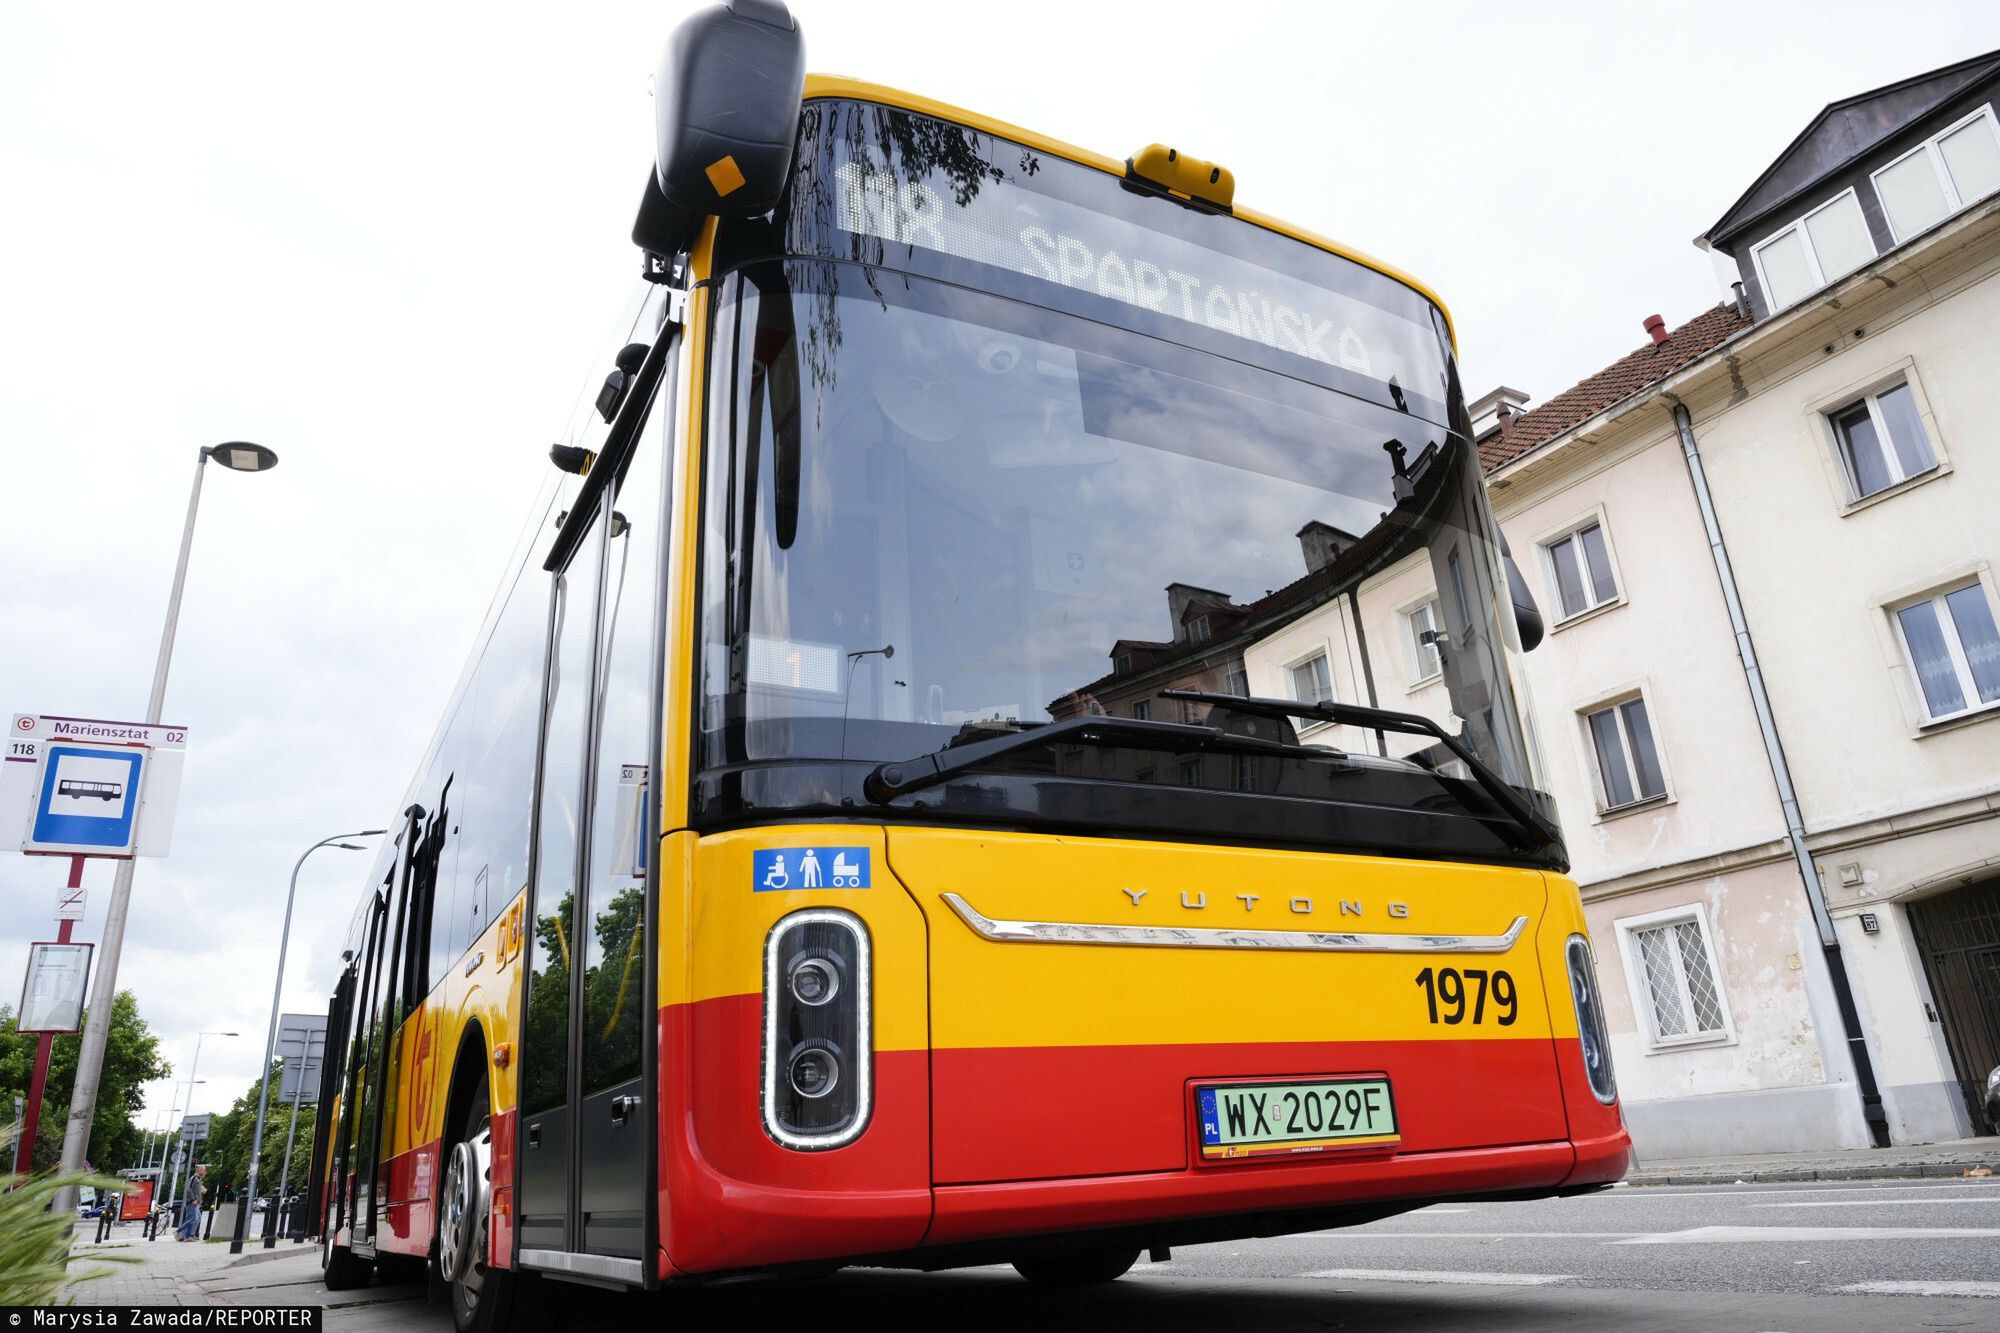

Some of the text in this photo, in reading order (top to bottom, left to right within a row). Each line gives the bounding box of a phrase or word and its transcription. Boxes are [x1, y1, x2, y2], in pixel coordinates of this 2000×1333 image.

[1019, 225, 1373, 377] SPARTAŃSKA
[54, 722, 184, 743] Mariensztat 02
[12, 743, 35, 756] 118
[1123, 888, 1410, 918] YUTONG
[1415, 967, 1518, 1026] 1979
[1224, 1088, 1381, 1138] WX 2029F
[1204, 1122, 1218, 1136] PL
